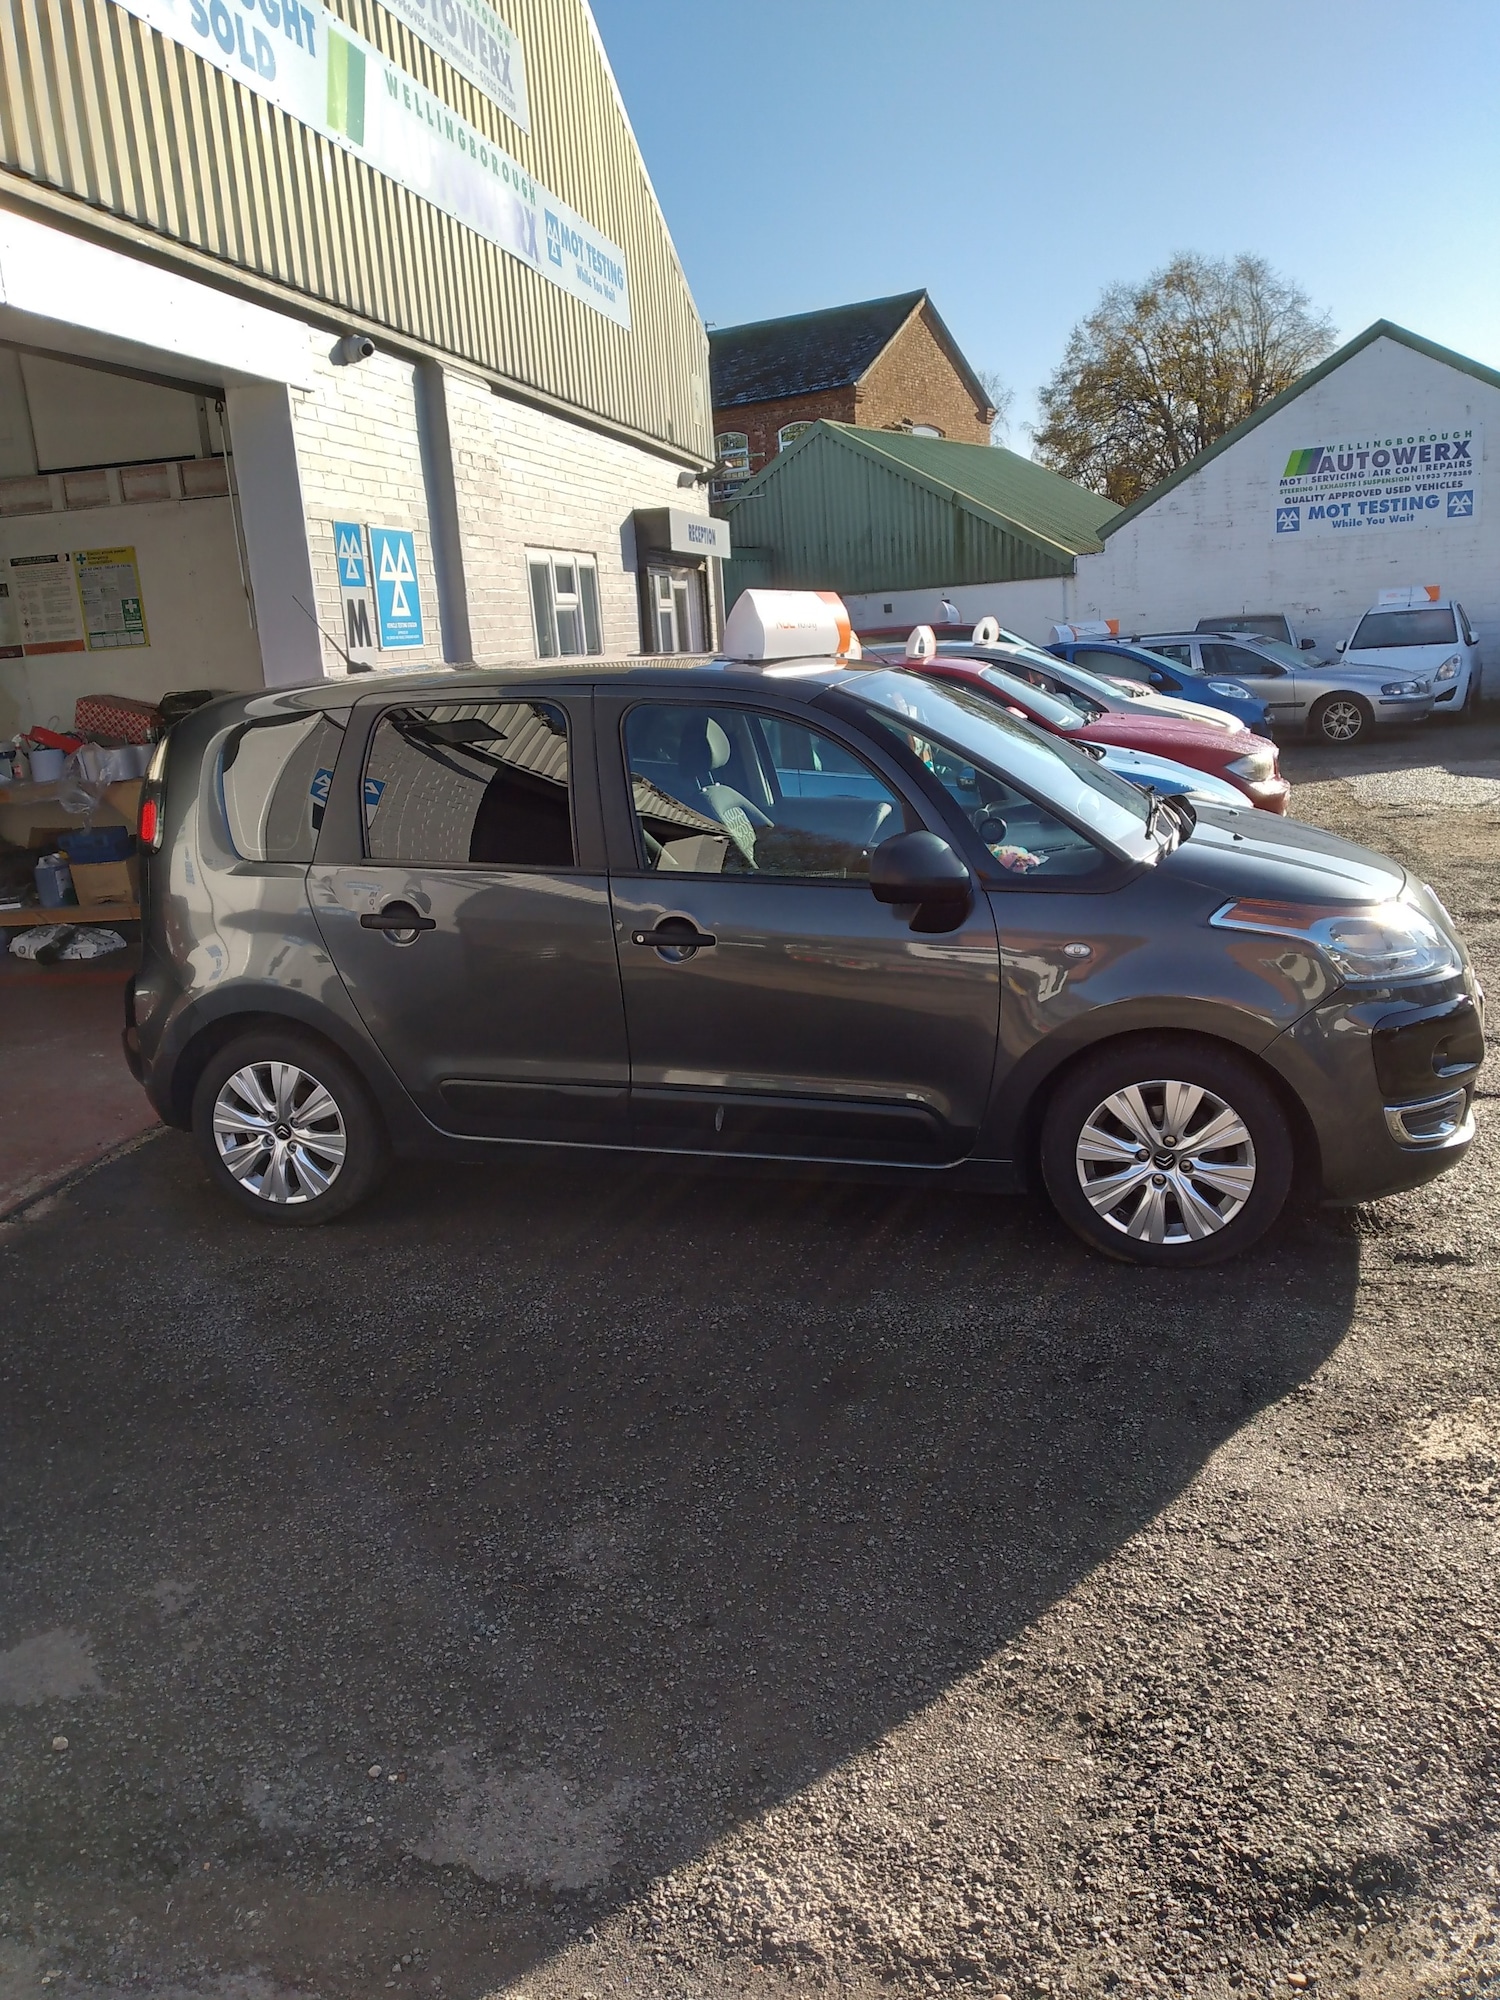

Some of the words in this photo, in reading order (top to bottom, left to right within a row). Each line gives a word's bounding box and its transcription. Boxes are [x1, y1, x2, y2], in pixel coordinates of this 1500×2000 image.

[190, 0, 277, 82] SOLD
[384, 68, 537, 207] WELLINGBOROUGH
[560, 221, 584, 262] MOT
[585, 240, 625, 292] TESTING
[575, 262, 592, 288] While
[592, 275, 603, 295] You
[602, 282, 616, 304] Wait
[1326, 430, 1473, 453] WELLINGBOROUGH
[1317, 440, 1472, 474] AUTOWERX
[1279, 478, 1303, 487] MOT
[1311, 471, 1366, 484] SERVICING
[1372, 468, 1391, 477] AIR
[1395, 465, 1418, 475] CON
[1425, 459, 1473, 472] REPAIRS
[1279, 486, 1314, 495] STEERING
[1319, 481, 1357, 491] EXHAUSTS
[1362, 475, 1411, 486] SUSPENSION
[1416, 472, 1441, 481] 01933
[1284, 493, 1326, 505] QUALITY
[1328, 487, 1382, 501] APPROVED
[1385, 485, 1412, 495] USED
[1415, 480, 1463, 492] VEHICLES
[1308, 503, 1352, 520] MOT
[1357, 494, 1440, 516] TESTING
[1331, 518, 1363, 528] While
[1366, 516, 1386, 526] You
[1388, 513, 1415, 524] Wait
[687, 523, 717, 546] RECEPTION
[346, 598, 373, 648] M
